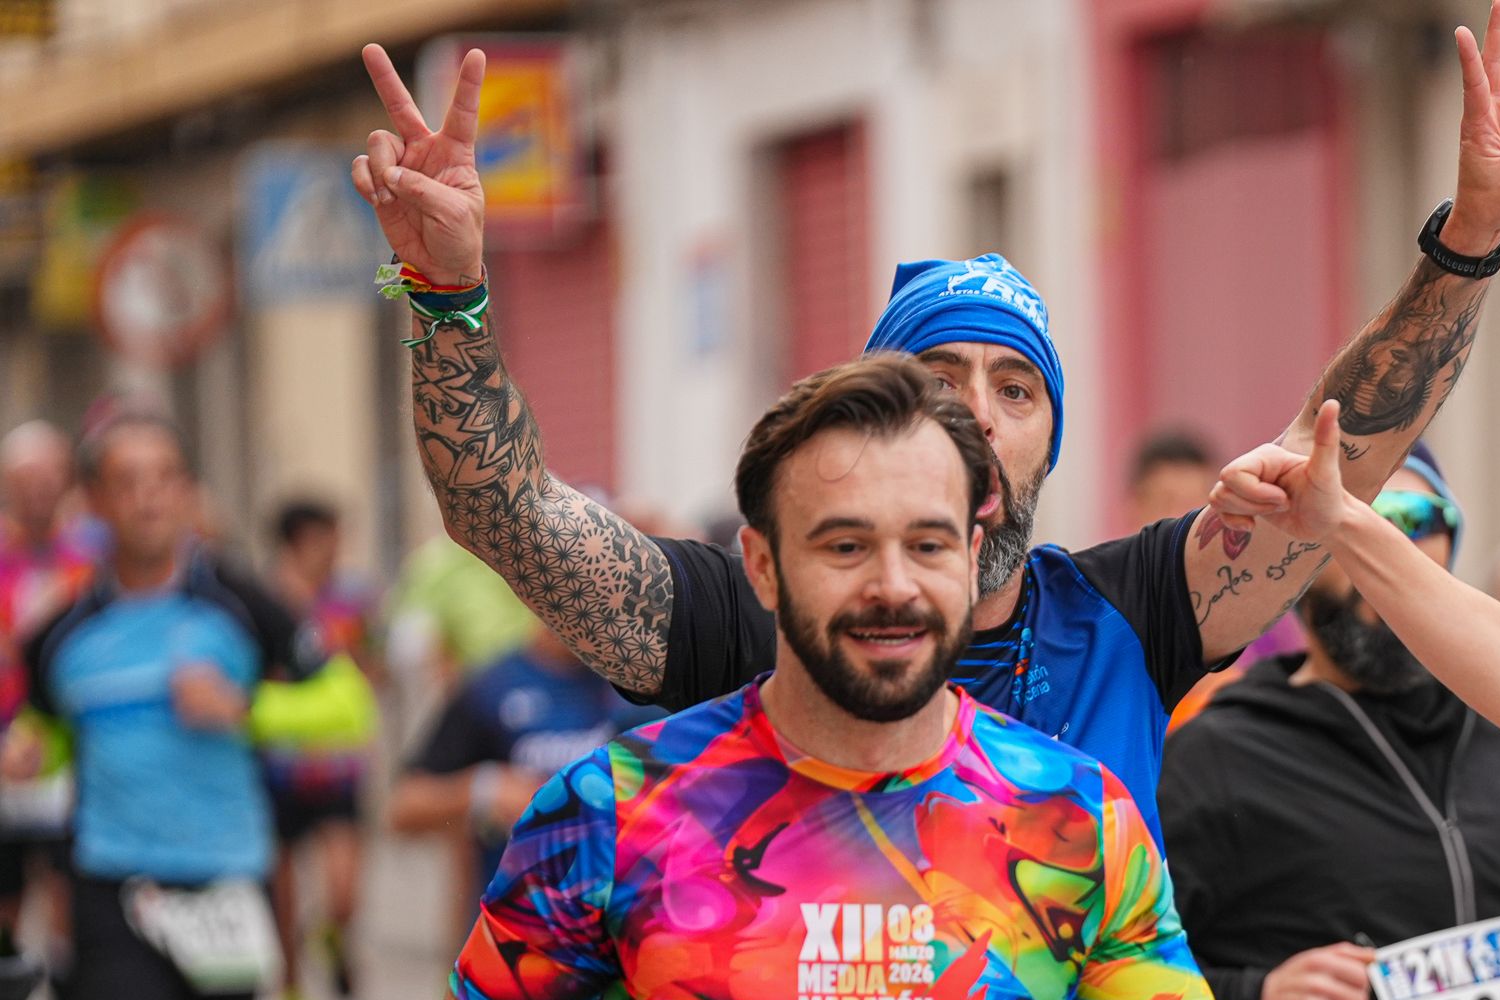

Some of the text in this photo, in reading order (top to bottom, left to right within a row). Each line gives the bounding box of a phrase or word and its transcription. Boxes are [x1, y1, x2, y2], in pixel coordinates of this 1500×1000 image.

[799, 903, 936, 962] XII 08
[797, 962, 936, 995] MEDIA 2026
